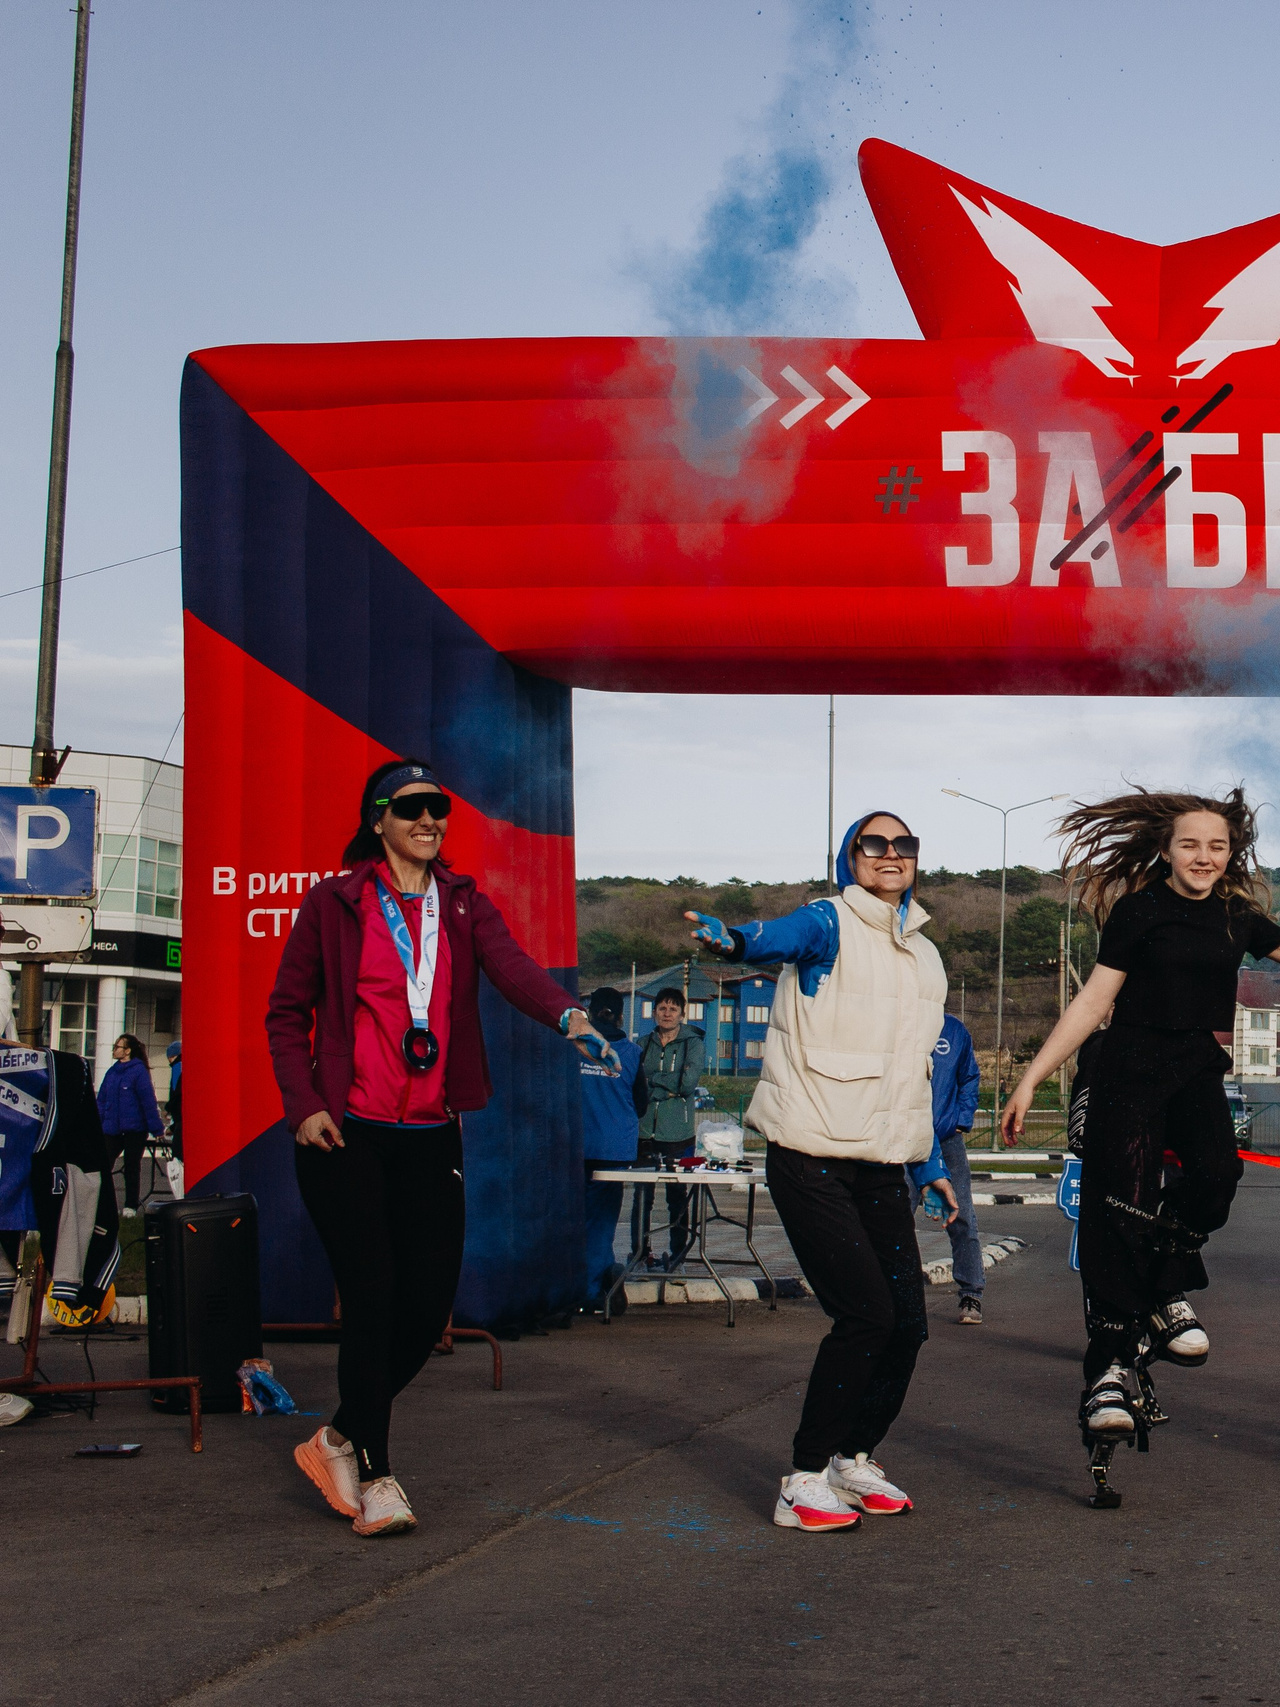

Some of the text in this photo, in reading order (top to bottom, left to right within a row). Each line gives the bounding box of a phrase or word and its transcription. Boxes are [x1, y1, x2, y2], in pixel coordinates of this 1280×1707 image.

[15, 805, 70, 879] P
[213, 867, 352, 899] В ритм
